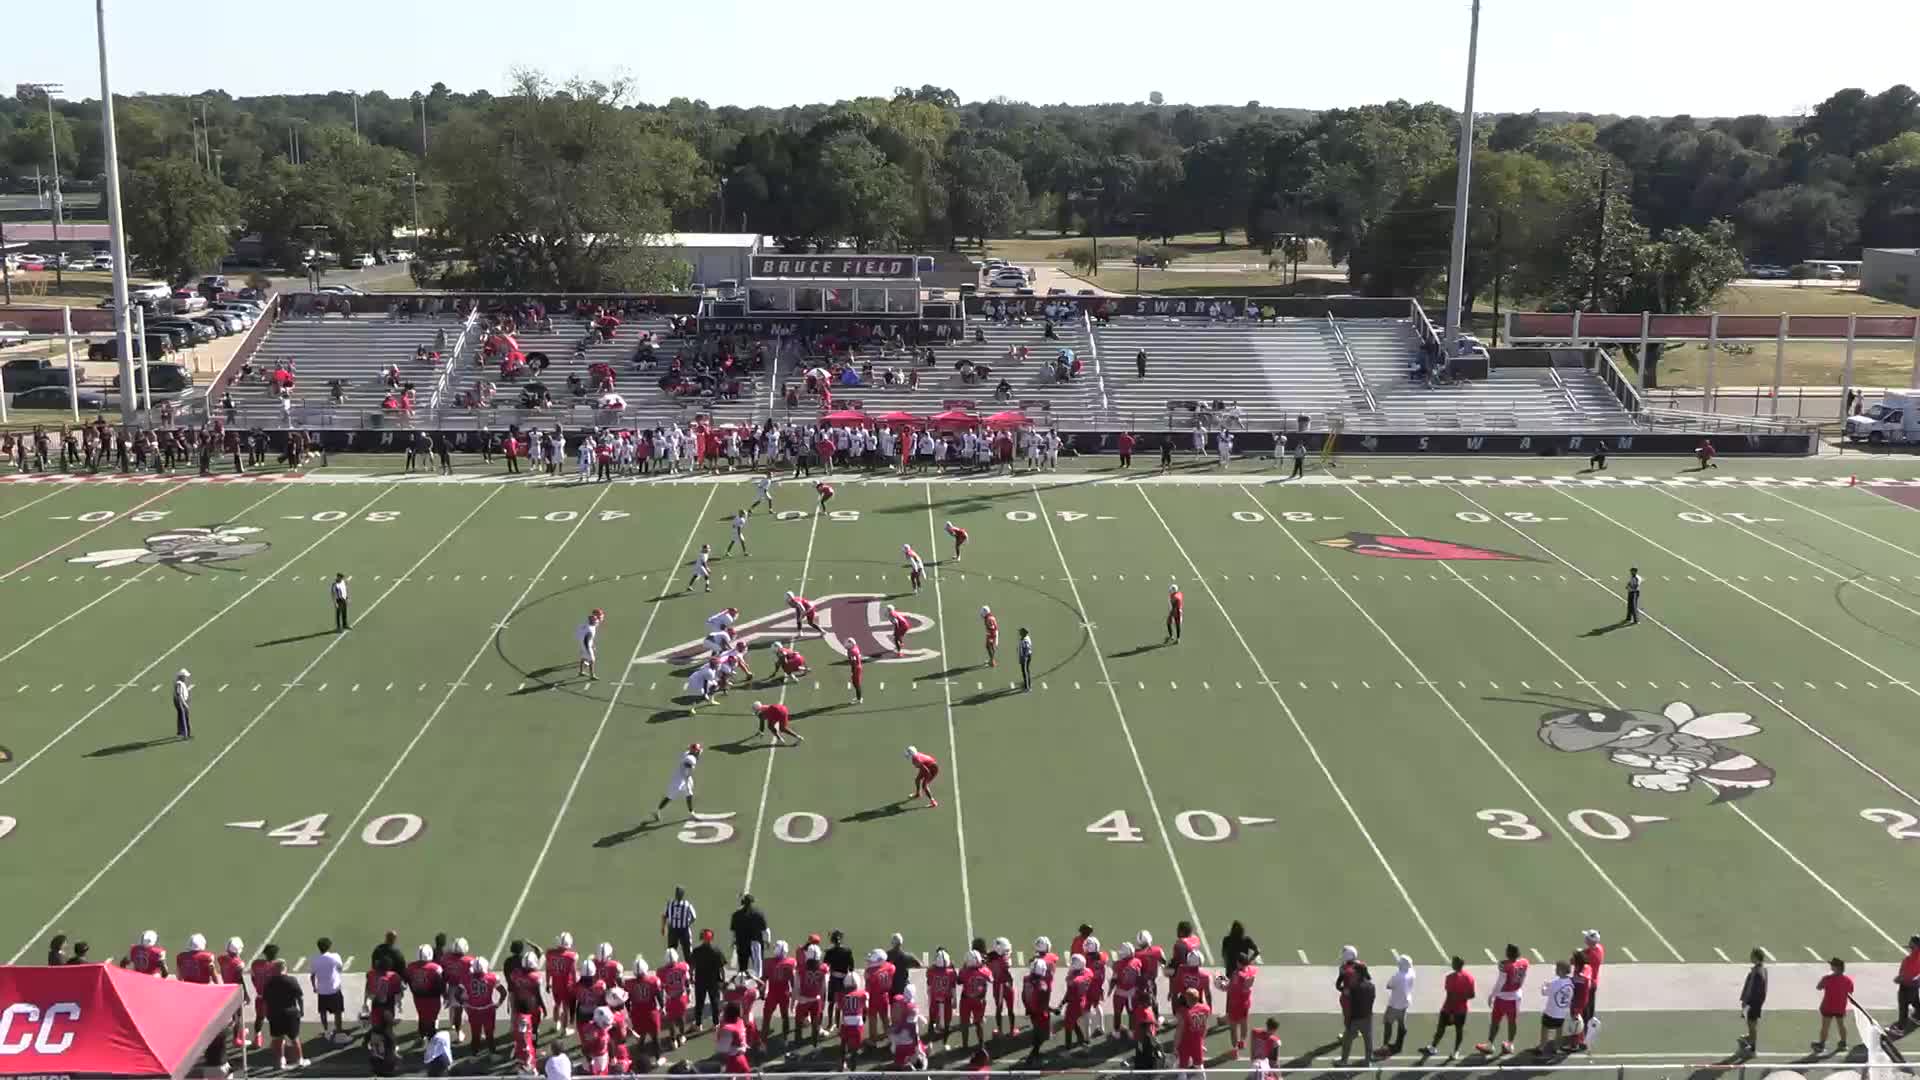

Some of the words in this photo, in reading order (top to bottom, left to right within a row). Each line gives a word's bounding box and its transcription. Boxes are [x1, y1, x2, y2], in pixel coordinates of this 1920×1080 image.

[762, 260, 832, 273] BRUCE
[842, 261, 902, 274] FIELD
[311, 431, 503, 446] ATHNS
[1418, 436, 1633, 450] SWARM
[543, 510, 631, 522] 40
[1005, 510, 1089, 523] 40
[267, 812, 425, 847] 40
[676, 811, 831, 845] 50
[1084, 808, 1234, 844] 40
[1474, 808, 1633, 843] 30
